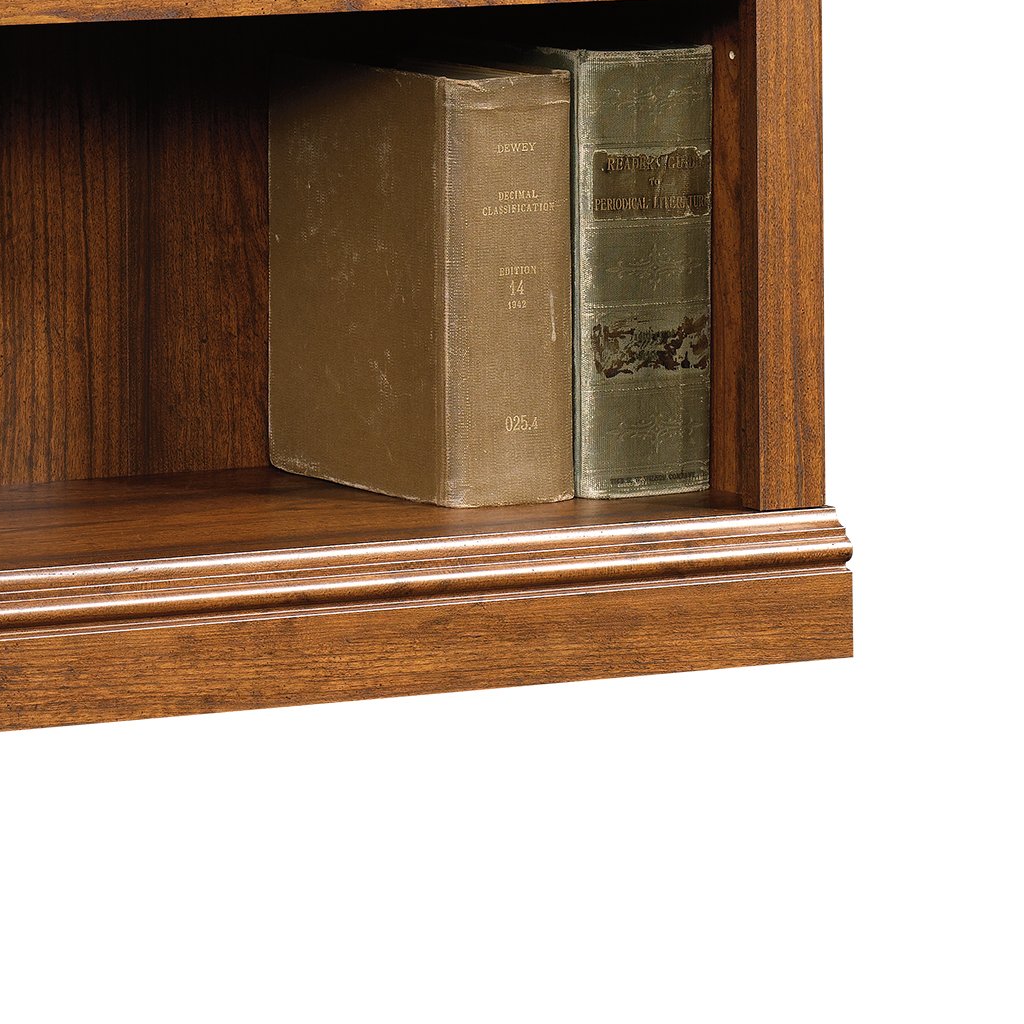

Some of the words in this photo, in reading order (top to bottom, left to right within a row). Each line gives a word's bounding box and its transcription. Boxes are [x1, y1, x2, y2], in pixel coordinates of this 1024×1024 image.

[497, 142, 536, 153] DEWEY
[498, 189, 539, 201] DECIMAL
[482, 202, 555, 216] CLASSIFICATION
[595, 197, 649, 211] PERIODICAL
[499, 265, 537, 276] EDITION
[509, 279, 525, 296] 14
[508, 300, 527, 310] 1942
[505, 414, 538, 432] 025.4
